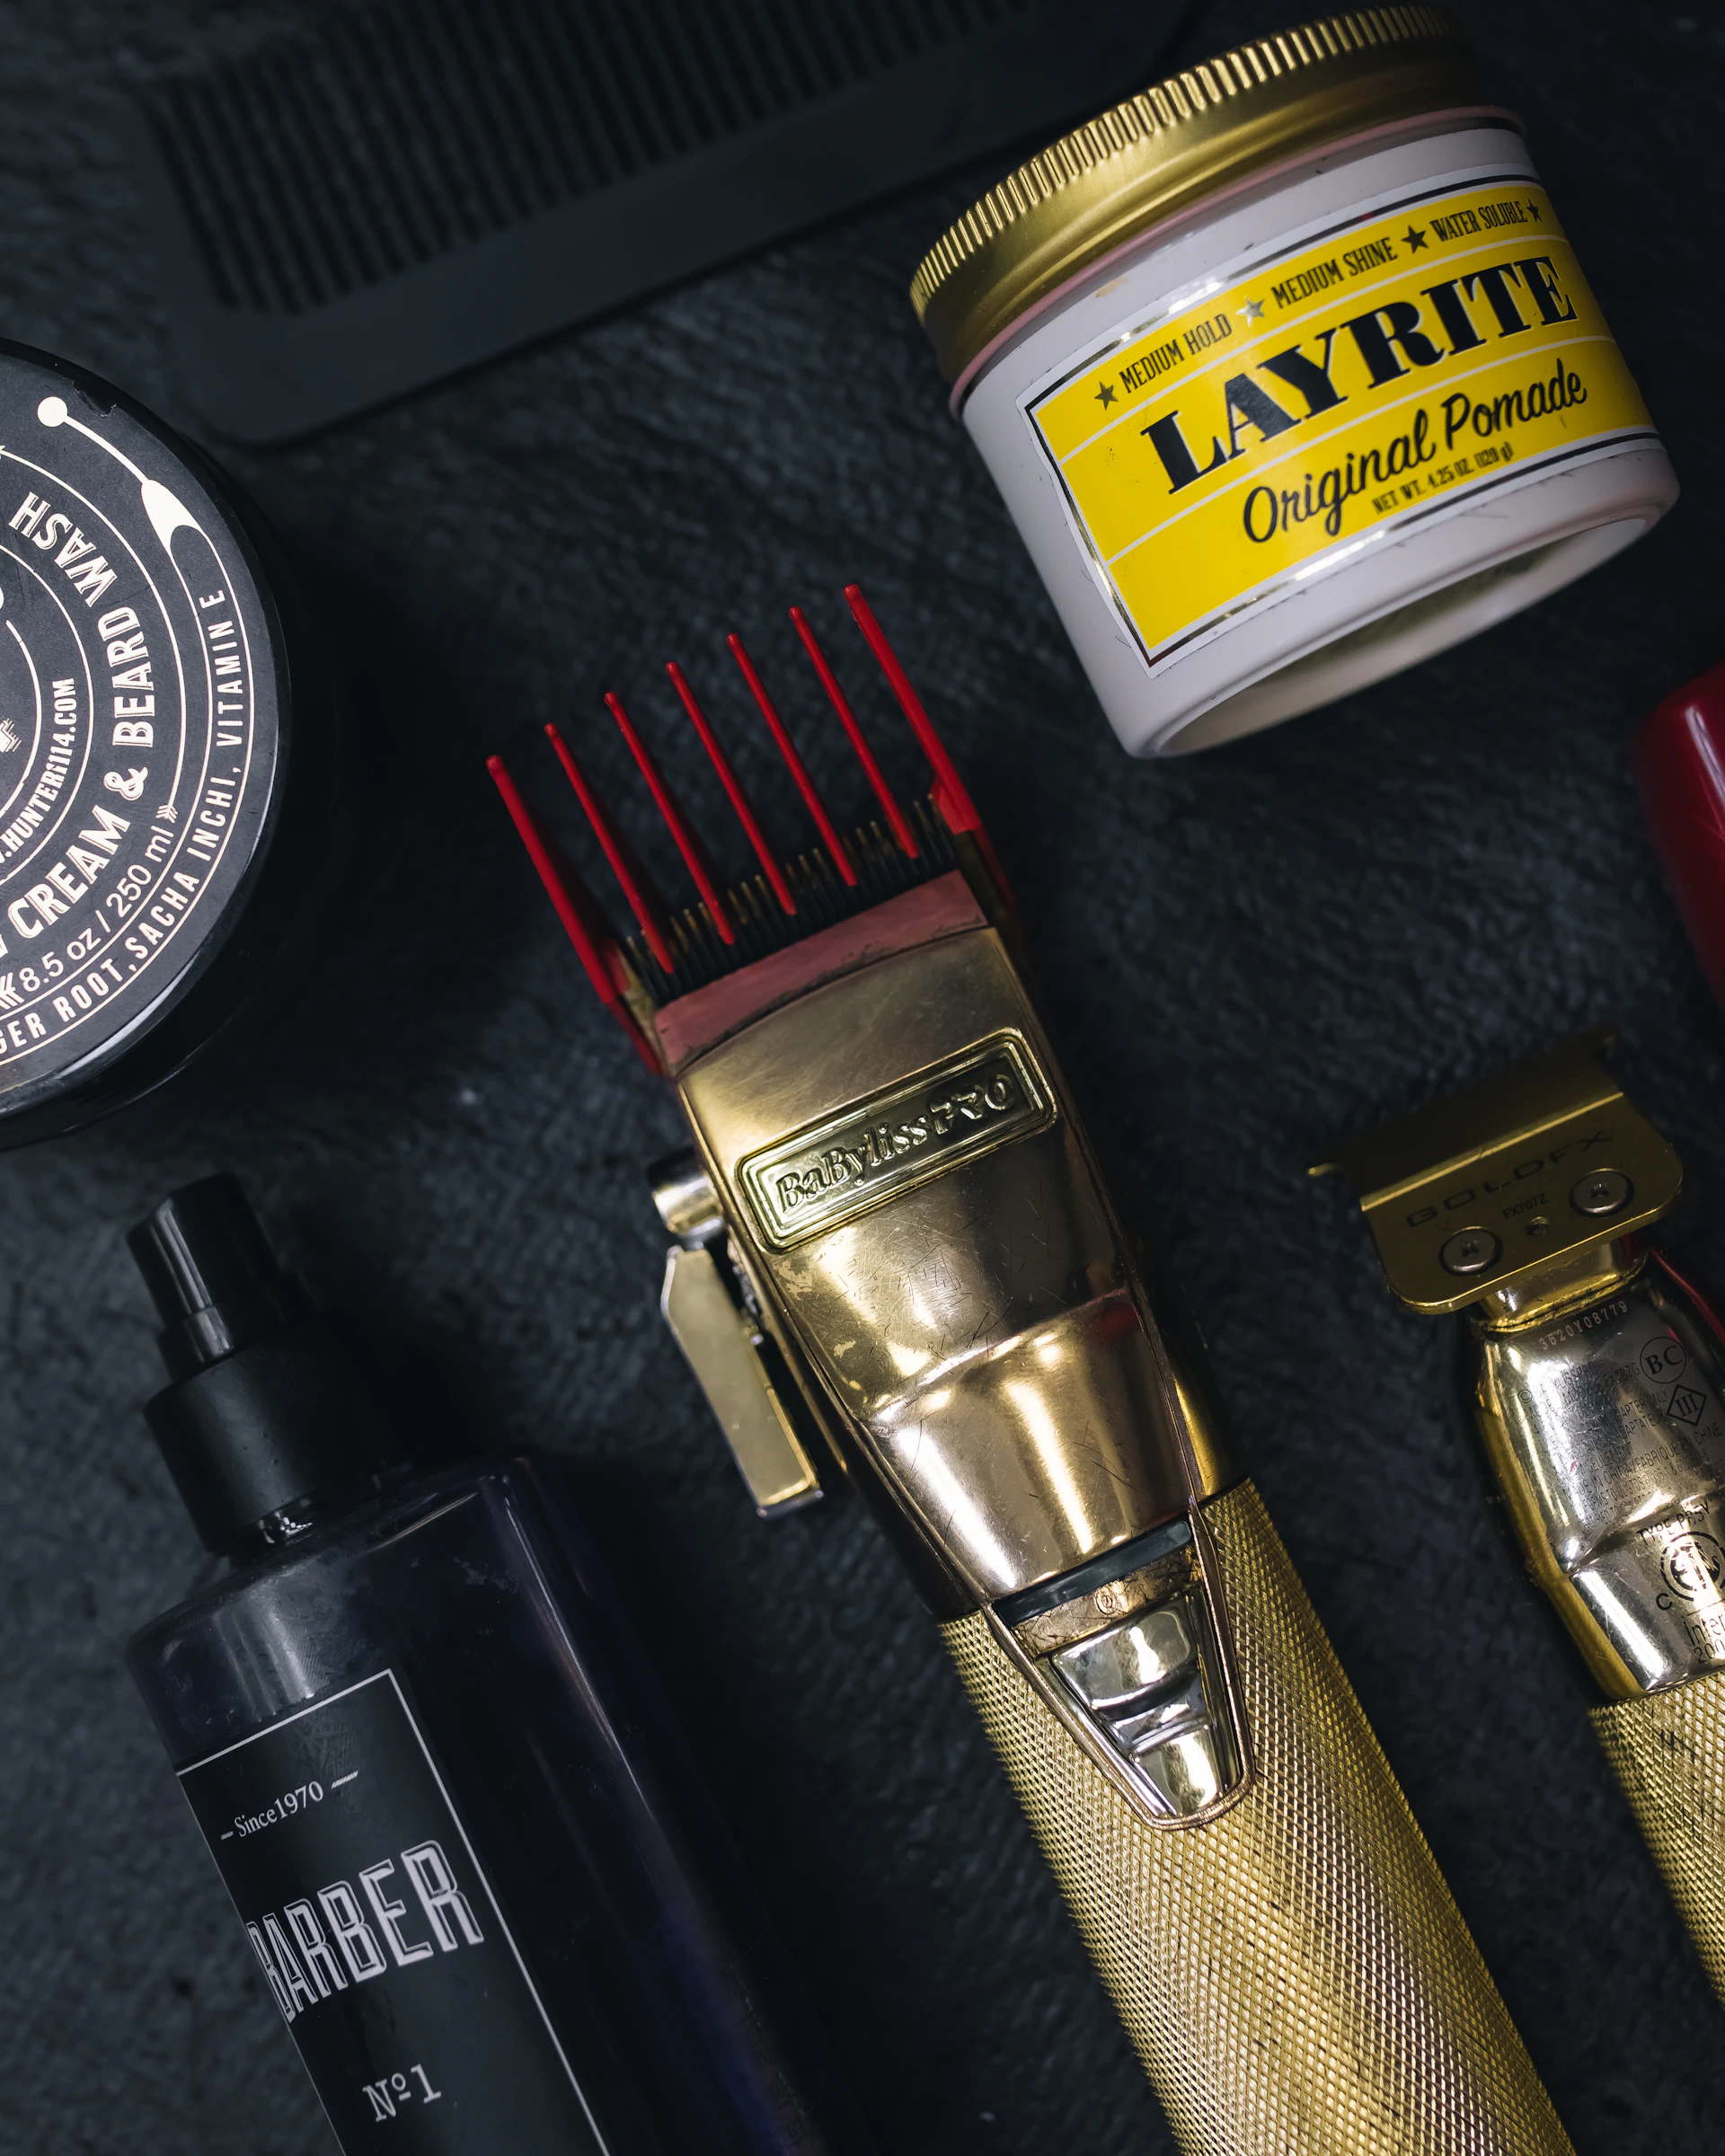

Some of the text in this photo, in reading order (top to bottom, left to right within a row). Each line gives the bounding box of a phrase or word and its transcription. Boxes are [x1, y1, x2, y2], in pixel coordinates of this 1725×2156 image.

[1119, 200, 1528, 393] MEDIUM HOLD MEDIUM SHINE WATER SOLUBLE
[1142, 254, 1578, 495] LAYRITE
[1243, 358, 1588, 543] Original Pomade
[1372, 490, 1398, 514] NET
[1428, 465, 1455, 488] 4.25
[199, 589, 226, 608] E
[8, 491, 154, 938] CREAM & BEARD WASH
[208, 621, 243, 747] VITAMIN
[0, 678, 76, 863] .HUNTER1114.COM
[187, 766, 242, 862] INCHI,
[20, 952, 64, 992] 8.5
[66, 927, 101, 960] oz
[106, 864, 152, 917] 250
[145, 826, 173, 862] ml
[776, 1074, 1016, 1213] BaBylissPRO
[1407, 1131, 1611, 1227] GOLDFX
[245, 1840, 484, 2023] BARBER
